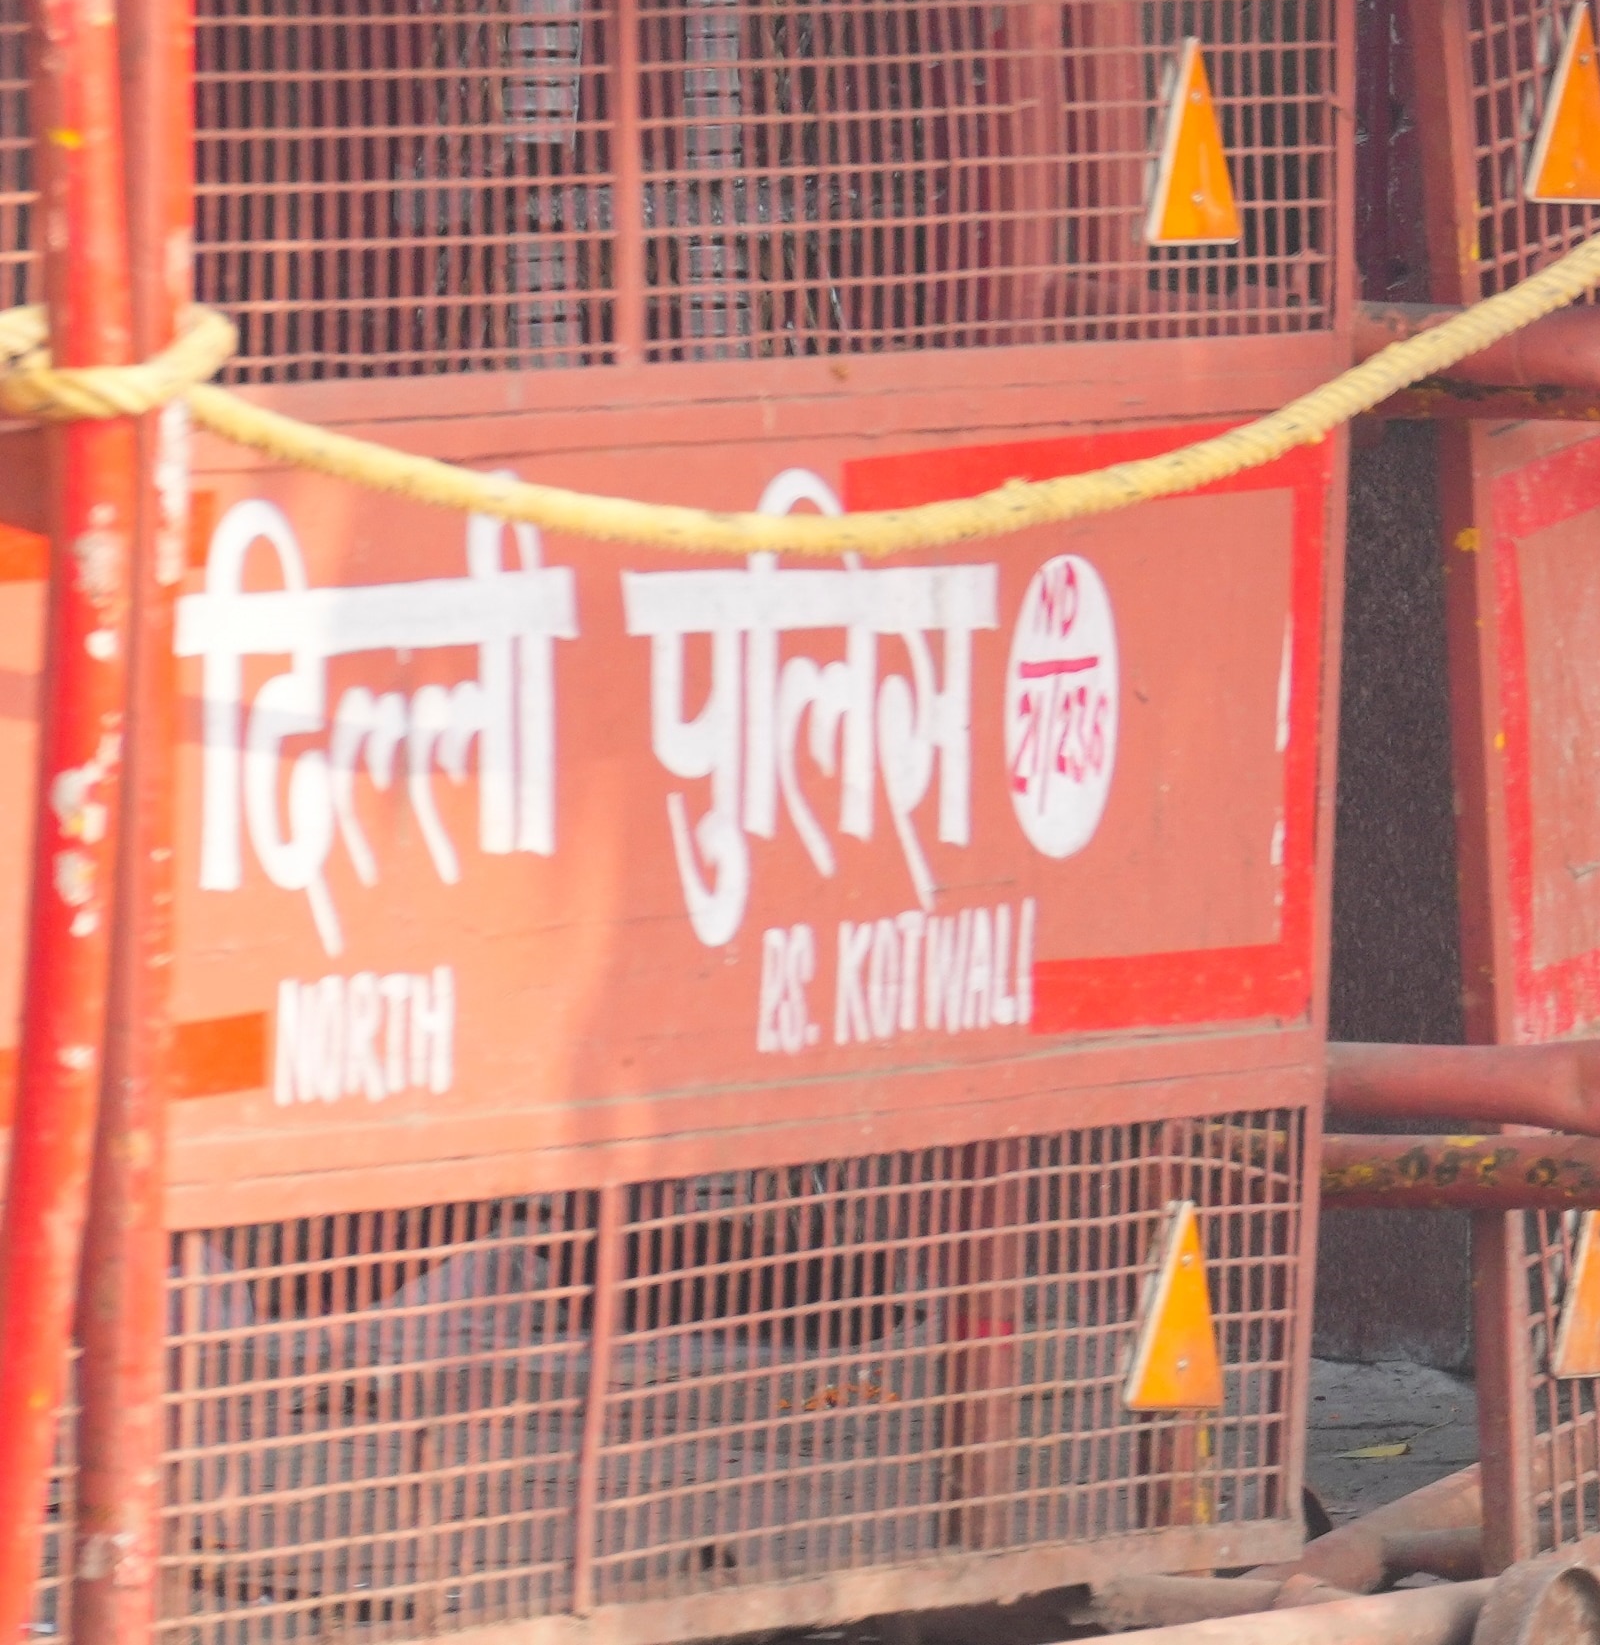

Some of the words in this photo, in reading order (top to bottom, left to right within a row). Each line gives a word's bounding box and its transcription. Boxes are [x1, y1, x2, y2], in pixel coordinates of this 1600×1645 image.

[174, 469, 579, 957] दिल्ली
[621, 468, 999, 946] पुलिस
[275, 965, 454, 1106] NORTH
[835, 897, 1035, 1046] KOTWALI
